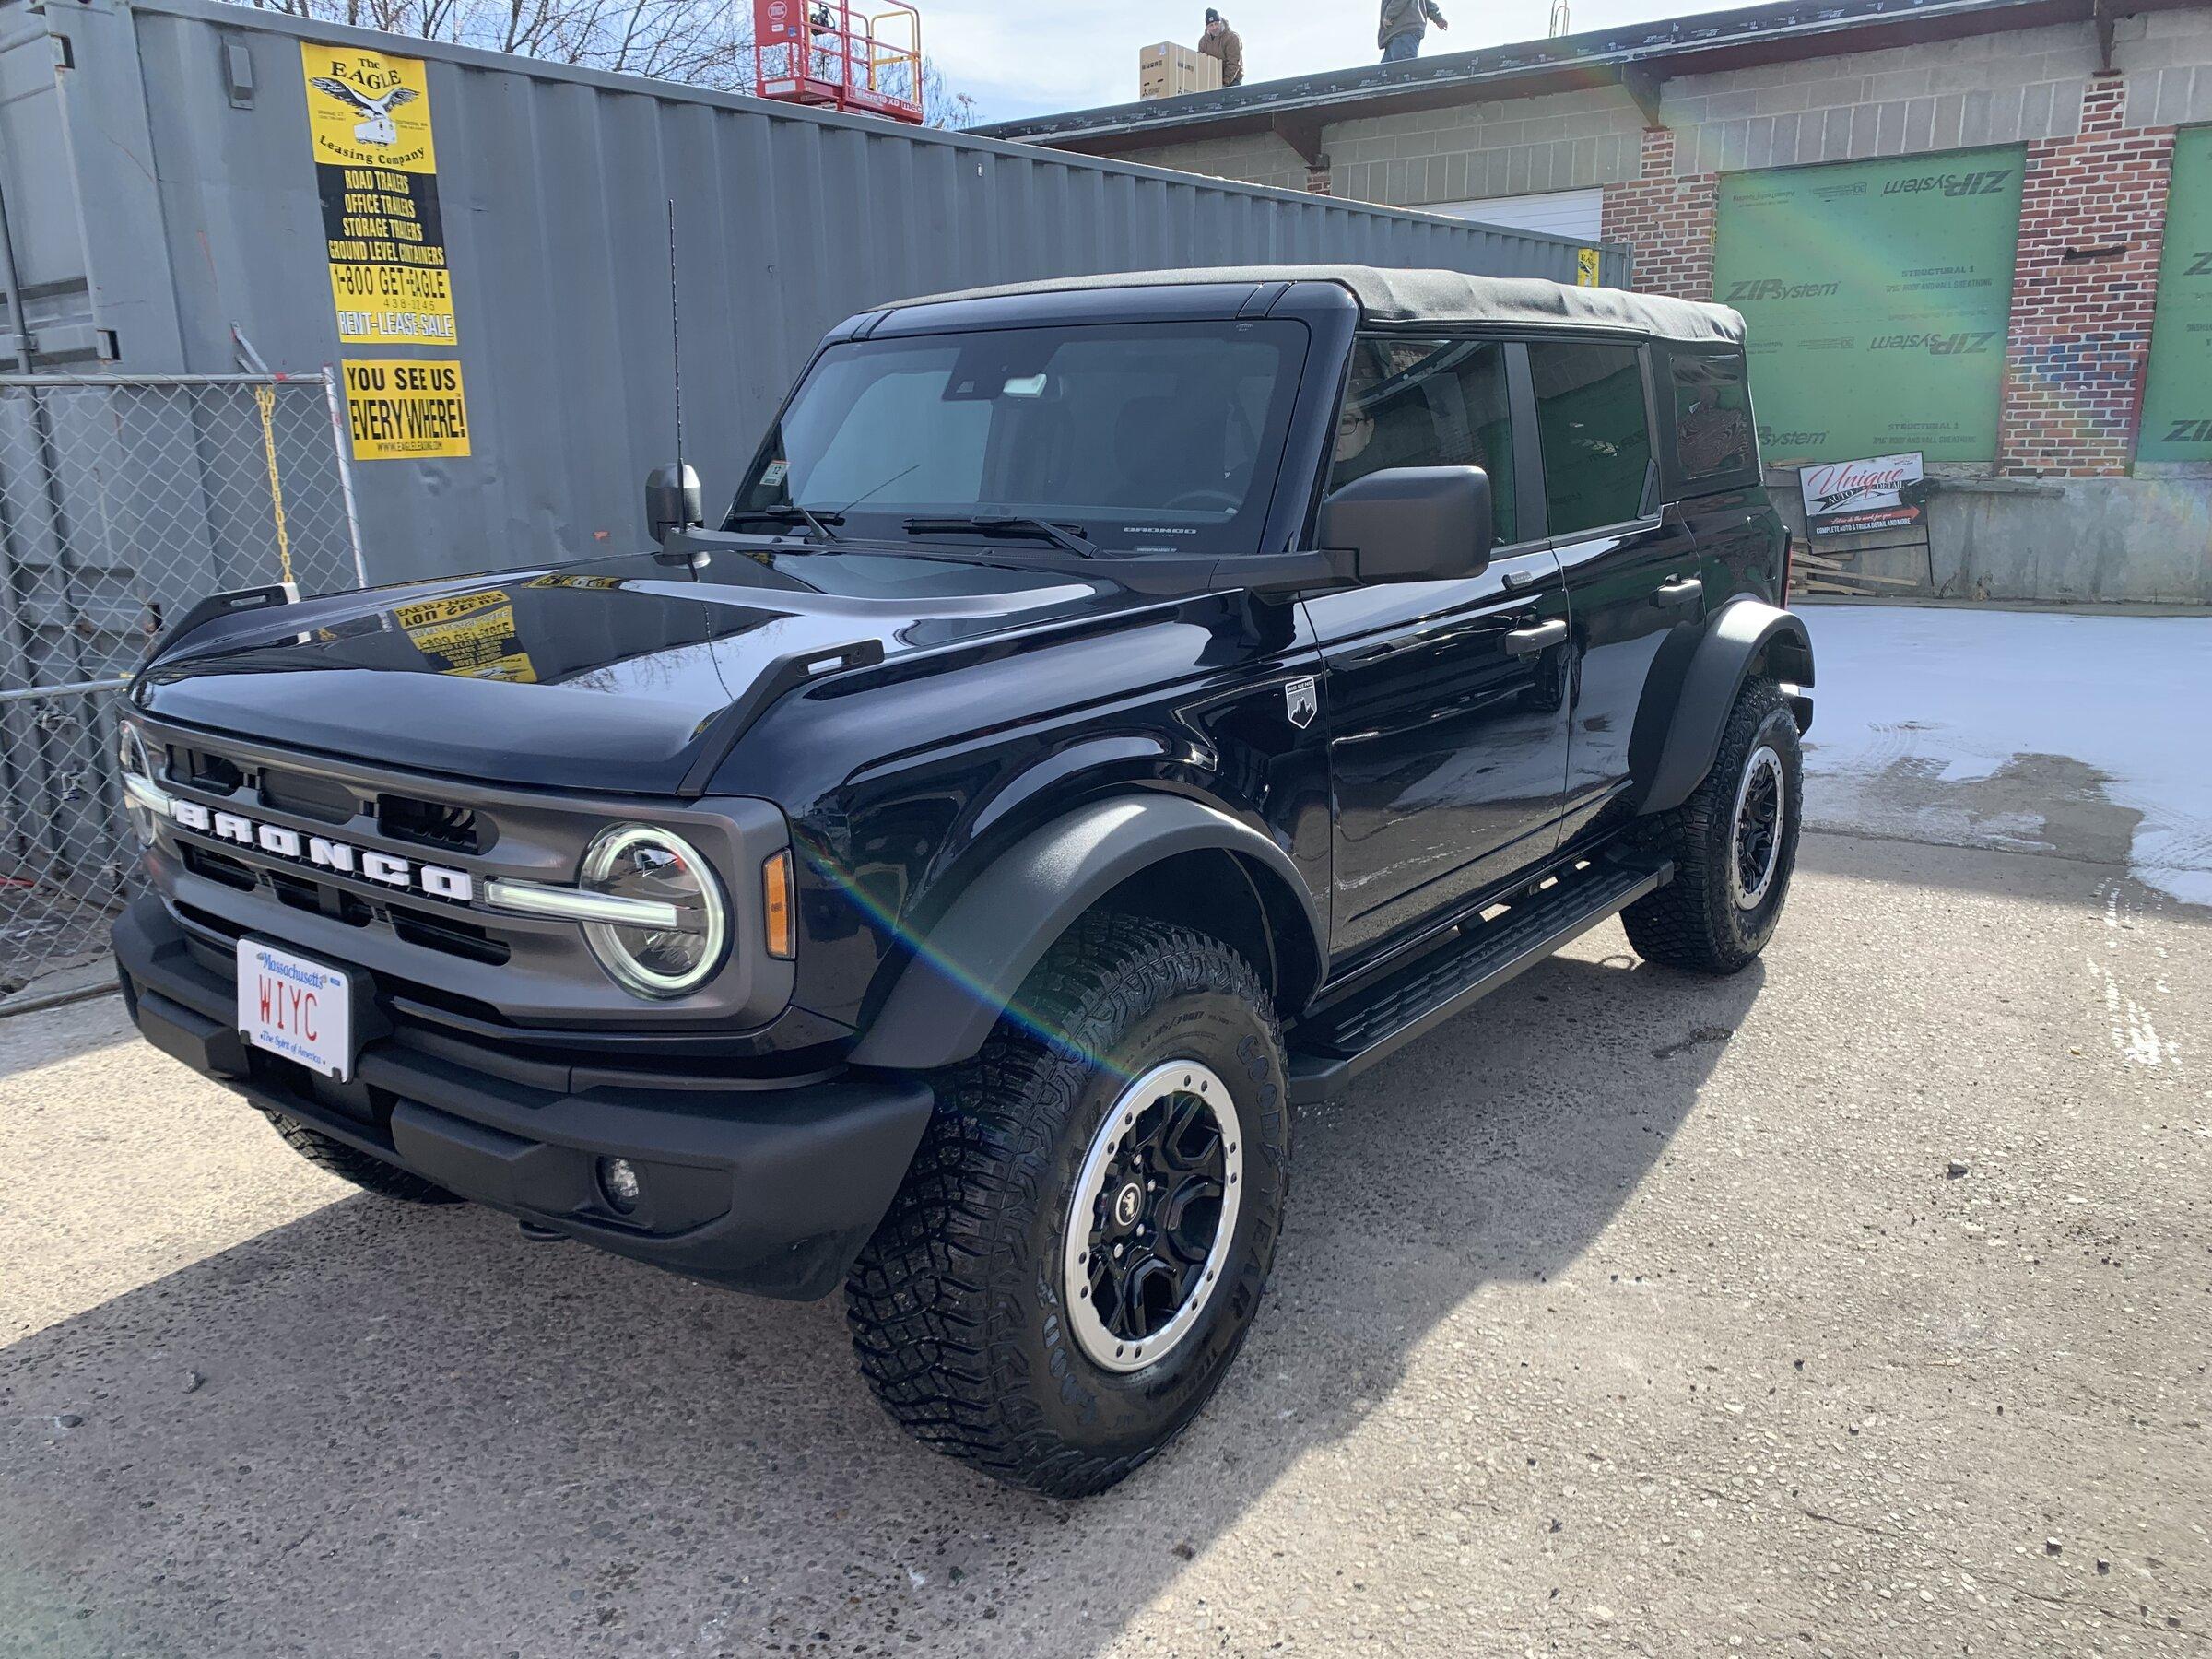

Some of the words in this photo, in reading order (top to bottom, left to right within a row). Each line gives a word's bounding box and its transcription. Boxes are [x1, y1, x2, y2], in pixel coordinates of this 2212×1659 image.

[331, 61, 401, 89] EAGLE
[358, 57, 380, 69] The
[319, 135, 373, 164] Leasing
[378, 147, 425, 166] Company
[344, 170, 372, 190] ROAD
[374, 171, 409, 194] TRAILERS
[345, 194, 380, 214] OFFICE
[381, 195, 416, 218] TRAILERS
[343, 218, 388, 238] STORAGE
[389, 219, 423, 241] TRAILERS
[328, 240, 367, 260] GROUND
[370, 241, 398, 262] LEVEL
[399, 243, 444, 265] CONTAINERS
[335, 266, 373, 295] 1-800
[380, 267, 446, 299] GET-EAGLE
[1901, 266, 1966, 277] STRUCTURAL
[347, 367, 385, 391] YOU
[394, 368, 427, 391] SEE
[430, 368, 456, 391] US
[349, 398, 465, 441] EVERYWHERE!
[1888, 422, 1952, 431] STRUCTURAL
[1808, 465, 1903, 498] Unique
[1877, 480, 1903, 490] DETAIL
[1828, 489, 1853, 504] AUTO
[1817, 524, 1840, 535] COMPLETE
[1871, 521, 1887, 529] DETAIL
[1897, 517, 1911, 525] MORE
[1298, 680, 1312, 689] BEND
[175, 799, 474, 900] BRONCO
[263, 952, 324, 990] Massachusetts
[259, 974, 317, 1041] WIYC
[262, 1030, 274, 1043] The
[276, 1034, 289, 1050] Spirit
[291, 1042, 297, 1054] of
[298, 1045, 322, 1064] America
